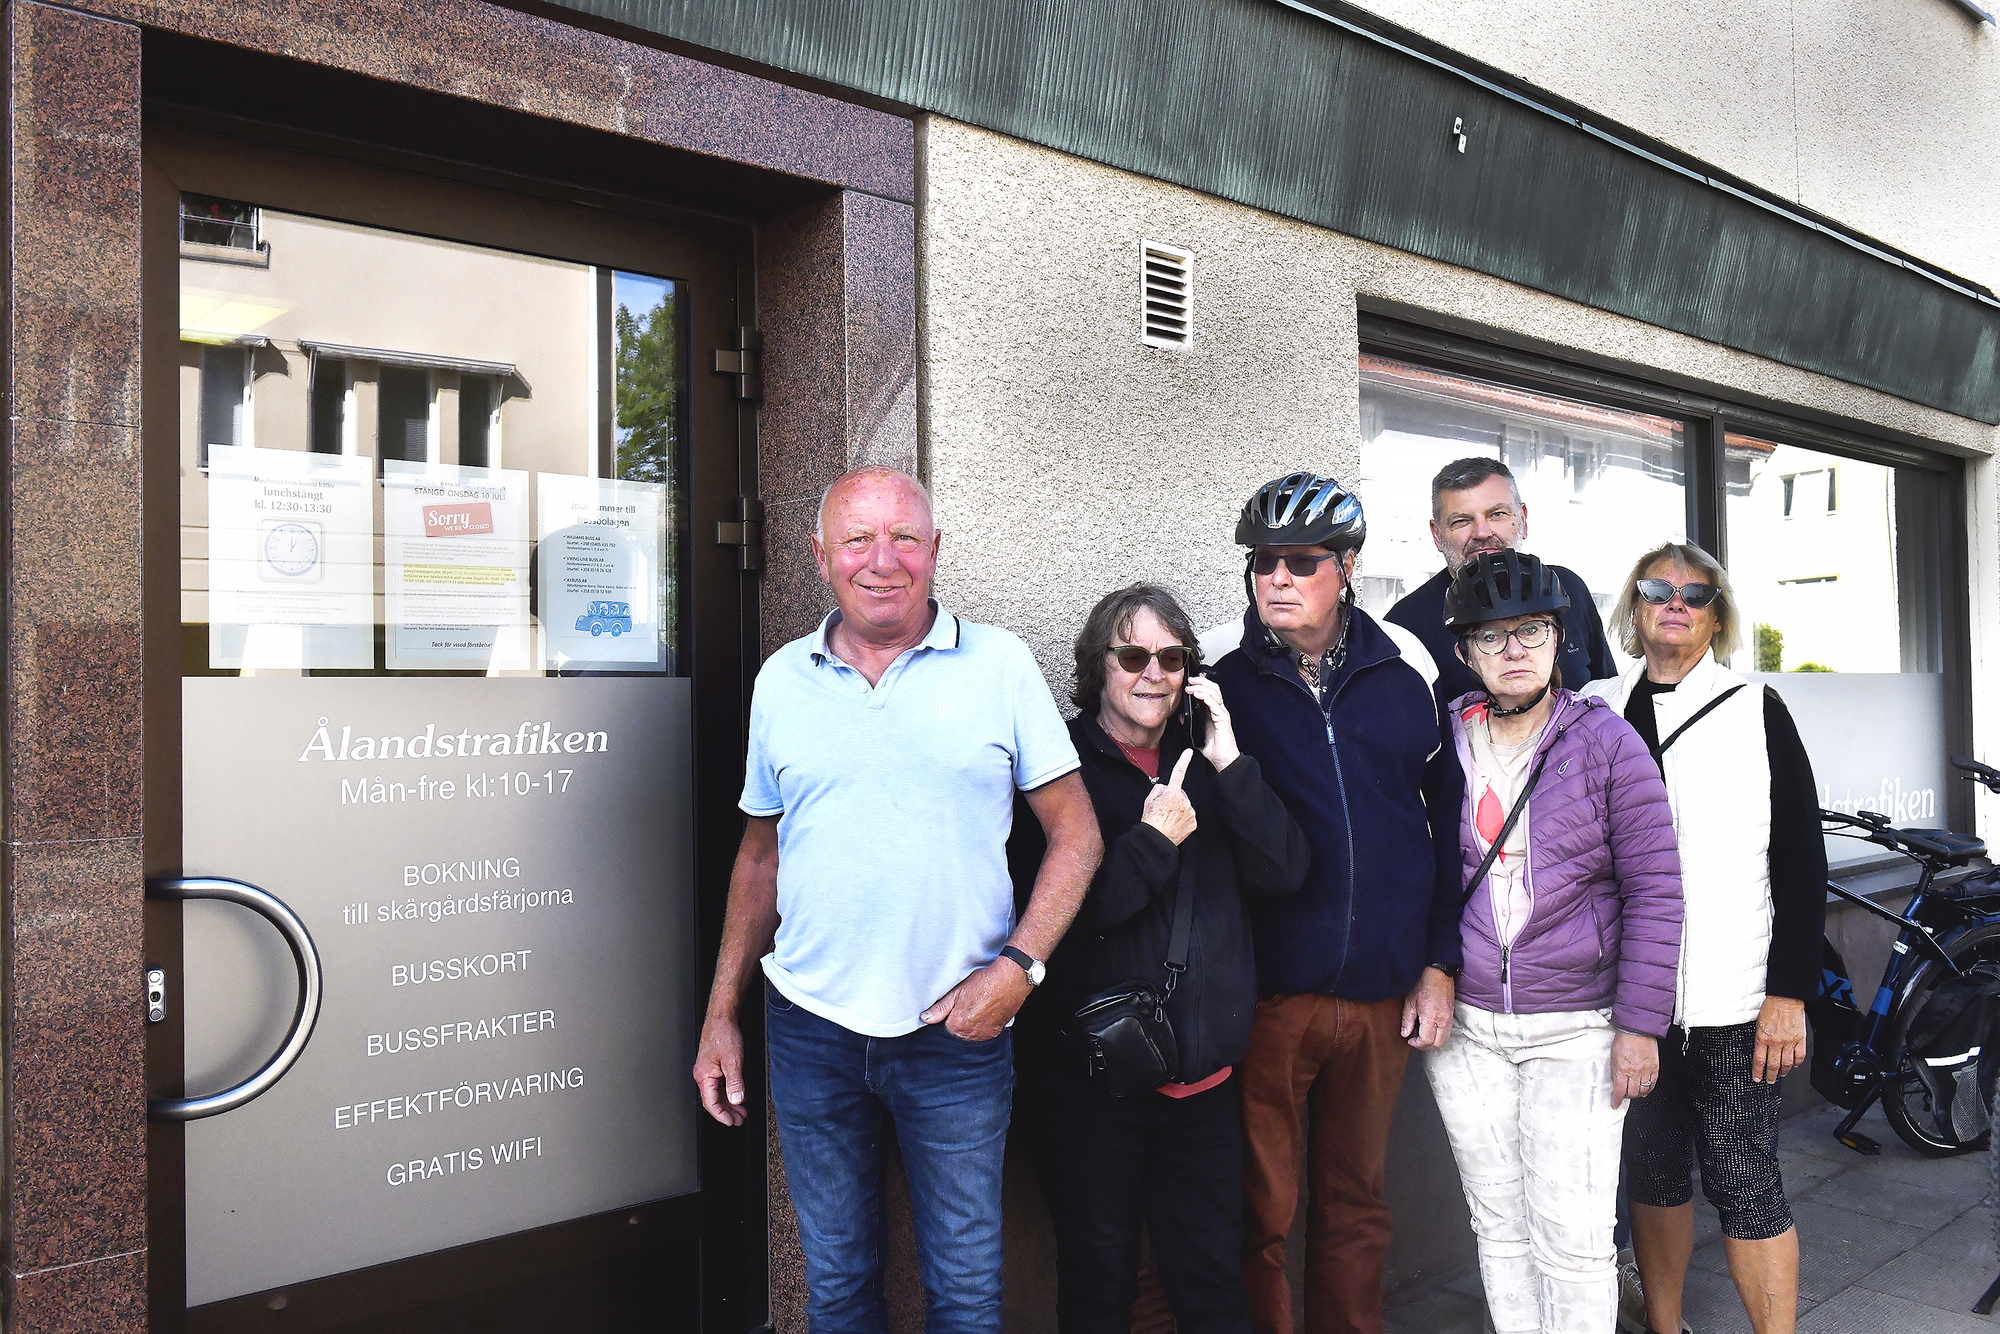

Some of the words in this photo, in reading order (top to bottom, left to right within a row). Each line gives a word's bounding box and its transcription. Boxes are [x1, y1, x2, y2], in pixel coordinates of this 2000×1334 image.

[254, 499, 267, 509] kl.
[271, 501, 332, 513] 12:30-13:30
[263, 486, 324, 502] lunchstängt
[414, 486, 445, 497] STÄNGD
[447, 489, 480, 499] ONSDAG
[482, 492, 490, 500] 10
[571, 501, 623, 513] Jourmmer
[625, 505, 636, 514] till
[428, 510, 470, 529] Sorry
[297, 716, 610, 762] Ålandstrafiken
[340, 773, 456, 805] Mån-fre
[466, 769, 575, 799] kl:10-17
[403, 856, 521, 887] BOKNING
[343, 902, 369, 926] till
[377, 887, 575, 923] skärgårdsfärjorna
[392, 949, 533, 987] BUSSKORT
[366, 1009, 556, 1057] BUSSFRAKTER
[335, 1066, 585, 1130] EFFEKTFÖRVARING
[386, 1147, 484, 1187] GRATIS
[490, 1136, 542, 1165] WIFI
